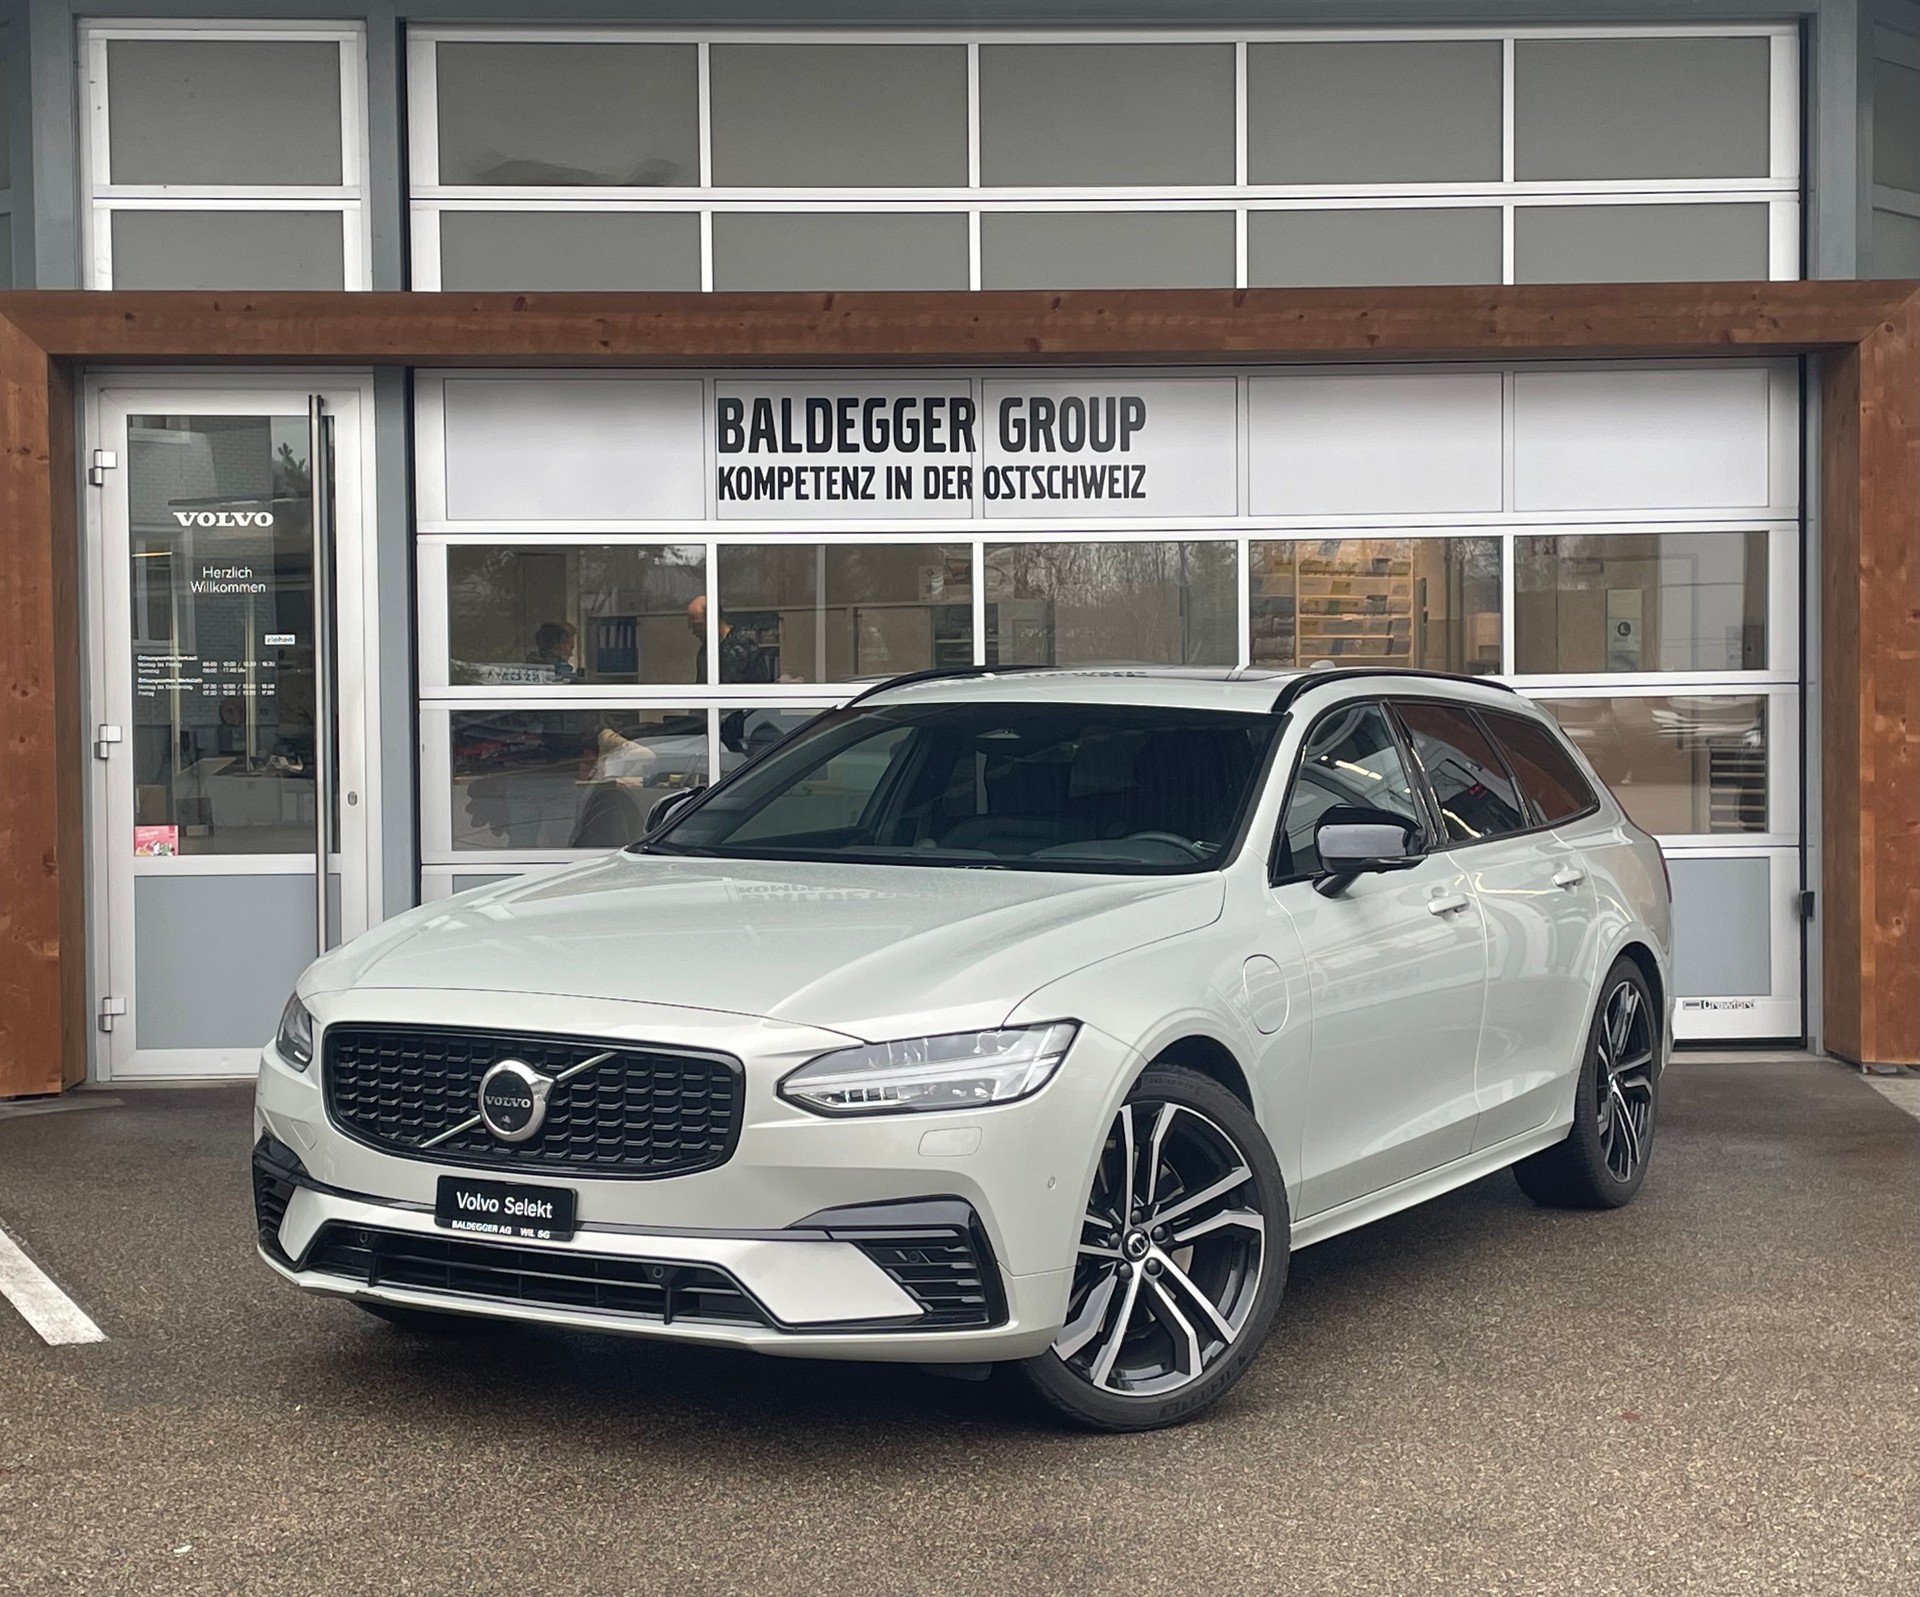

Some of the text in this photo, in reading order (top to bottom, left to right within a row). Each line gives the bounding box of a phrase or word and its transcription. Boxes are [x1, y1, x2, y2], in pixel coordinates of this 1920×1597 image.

[717, 396, 1146, 453] BALDEGGER GROUP
[718, 465, 1147, 500] KOMPETENZ IN DER OSTSCHWEIZ
[173, 512, 274, 527] VOLVO
[202, 566, 253, 579] Herzlich
[190, 580, 266, 593] Willkommen
[485, 1095, 531, 1109] VOLVO
[456, 1191, 553, 1219] Volvo Selekt
[452, 1219, 498, 1233] BALDEGGER
[499, 1225, 512, 1235] AG
[537, 1229, 551, 1239] SG
